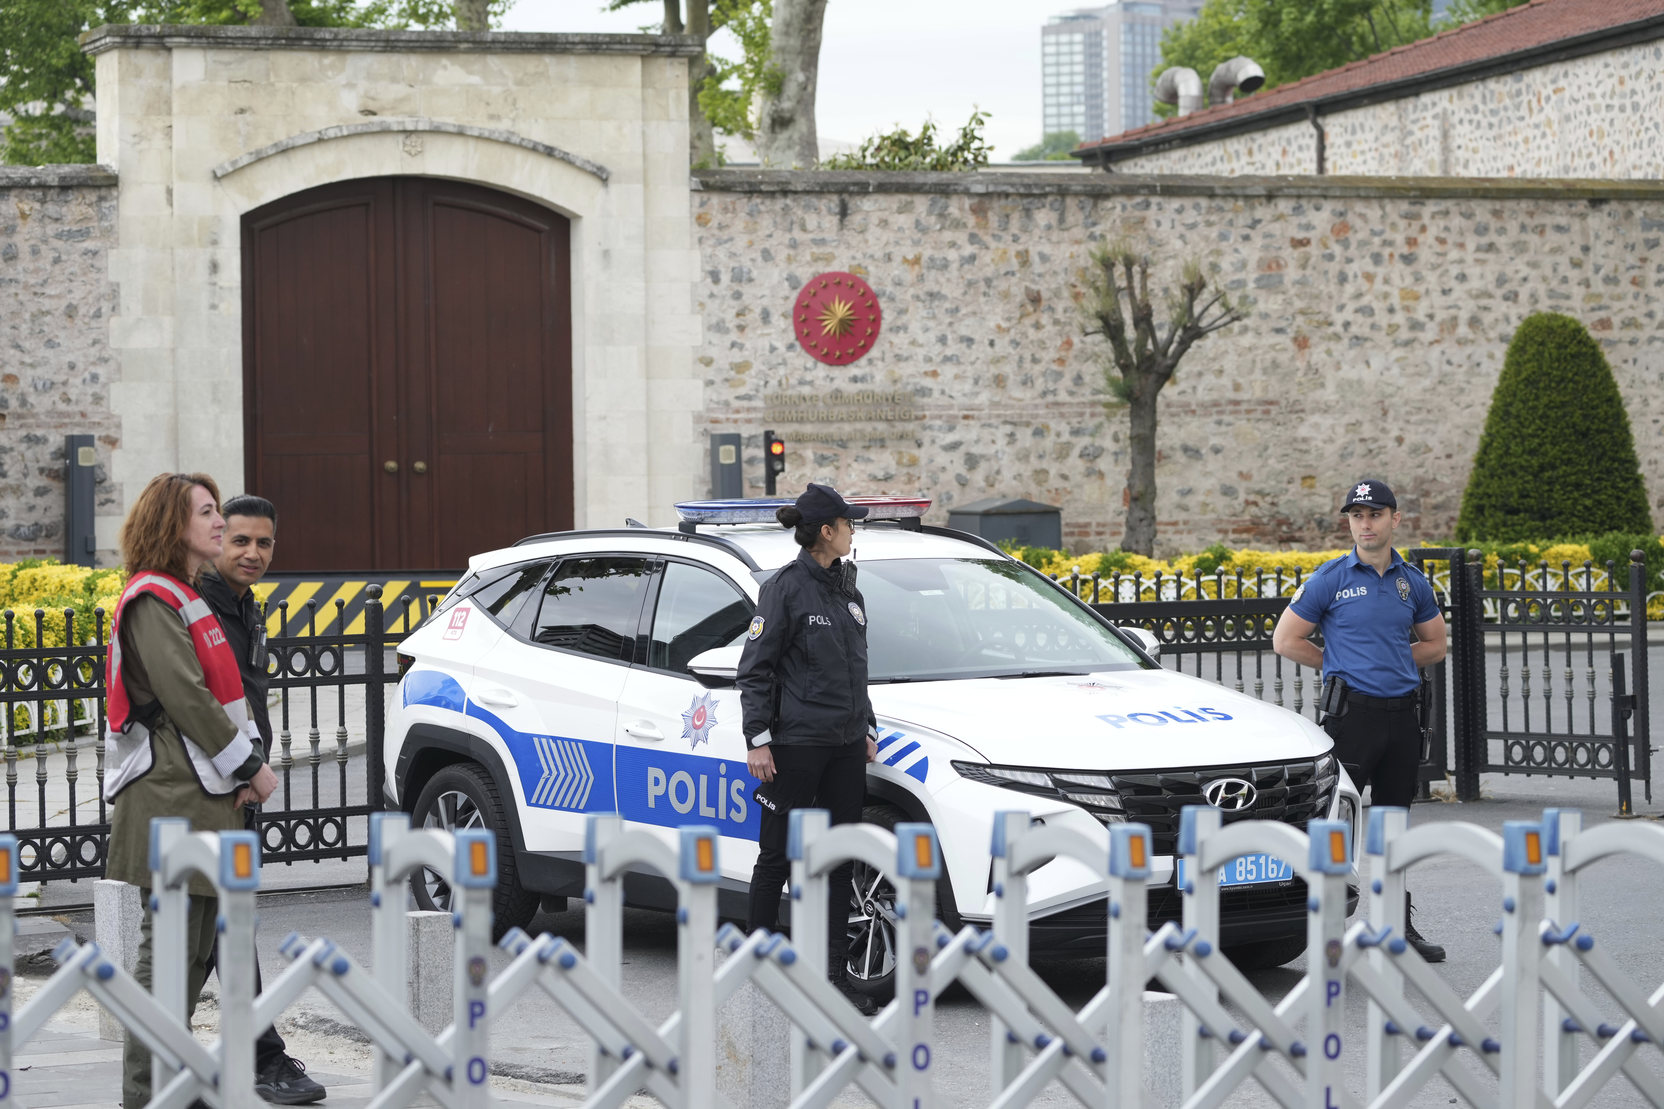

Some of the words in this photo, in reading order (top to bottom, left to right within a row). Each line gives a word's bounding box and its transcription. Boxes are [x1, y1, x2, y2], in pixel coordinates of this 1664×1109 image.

[1336, 586, 1368, 601] POLİS
[451, 610, 467, 627] 112
[1095, 706, 1233, 729] POLİS
[647, 762, 748, 824] POLİS
[756, 794, 776, 811] POLİS
